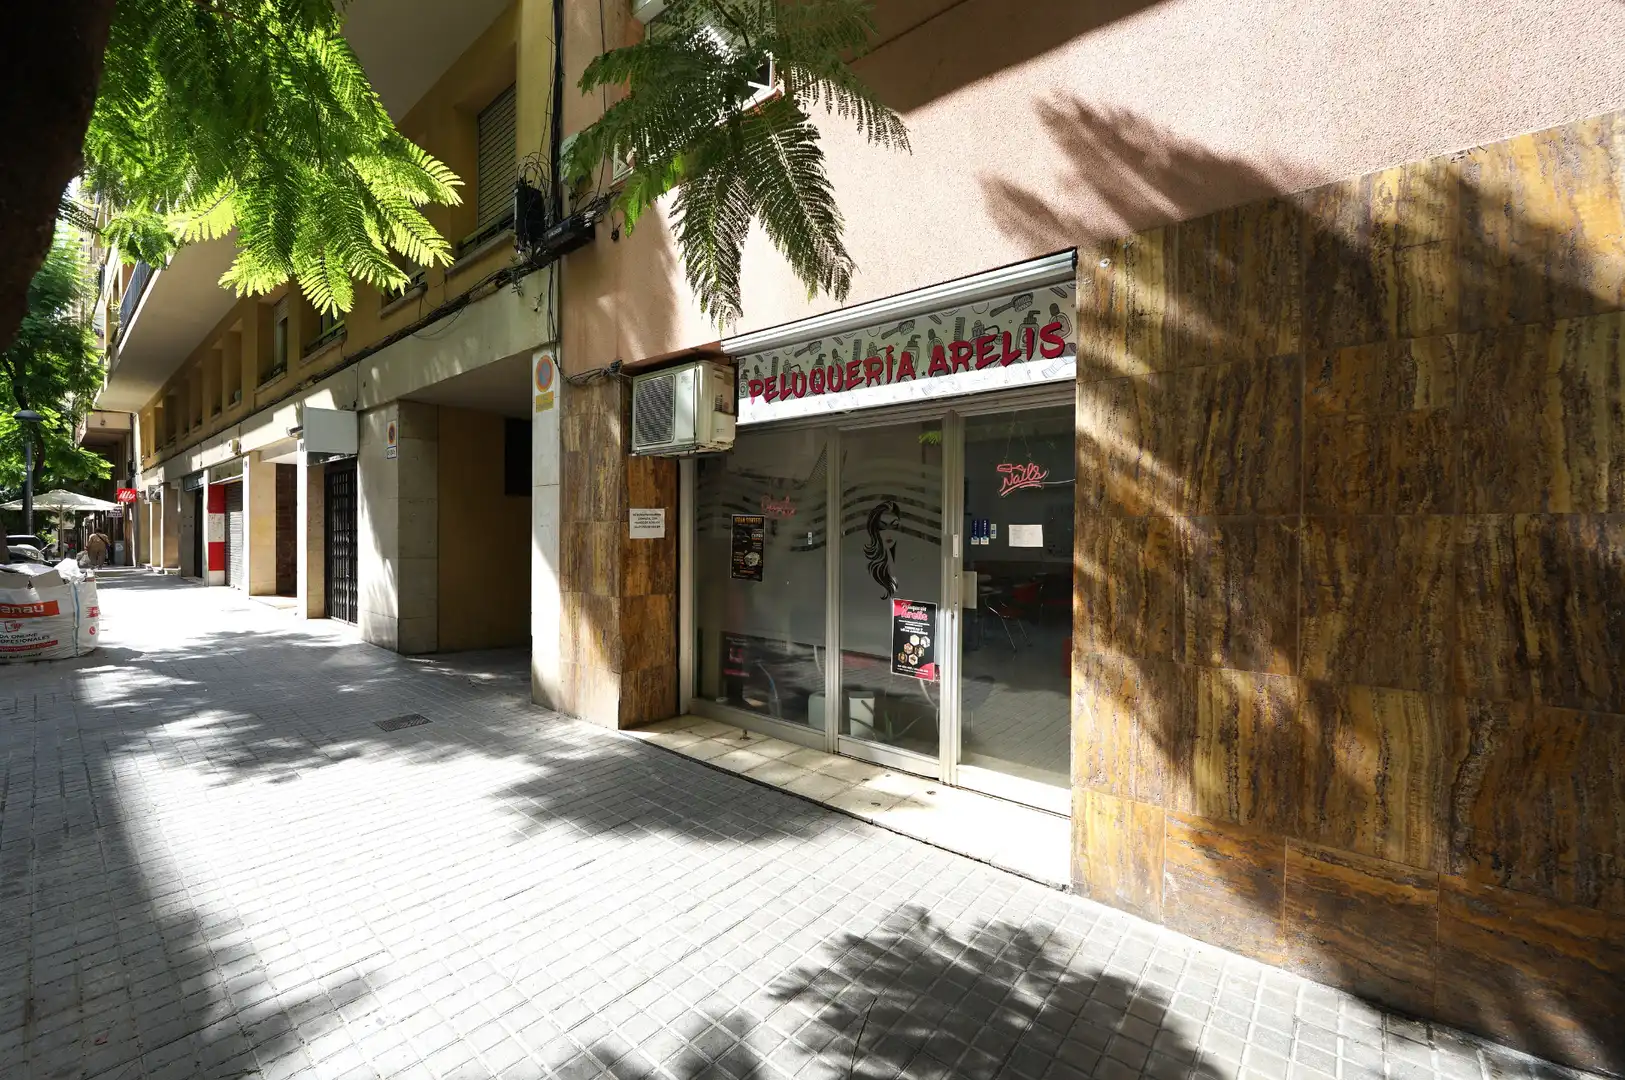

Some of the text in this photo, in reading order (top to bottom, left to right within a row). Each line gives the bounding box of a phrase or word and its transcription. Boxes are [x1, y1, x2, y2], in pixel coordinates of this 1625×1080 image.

[749, 322, 1066, 405] PELUQUERÍA ARELIS
[1000, 463, 1048, 492] Nails
[118, 490, 136, 501] illy
